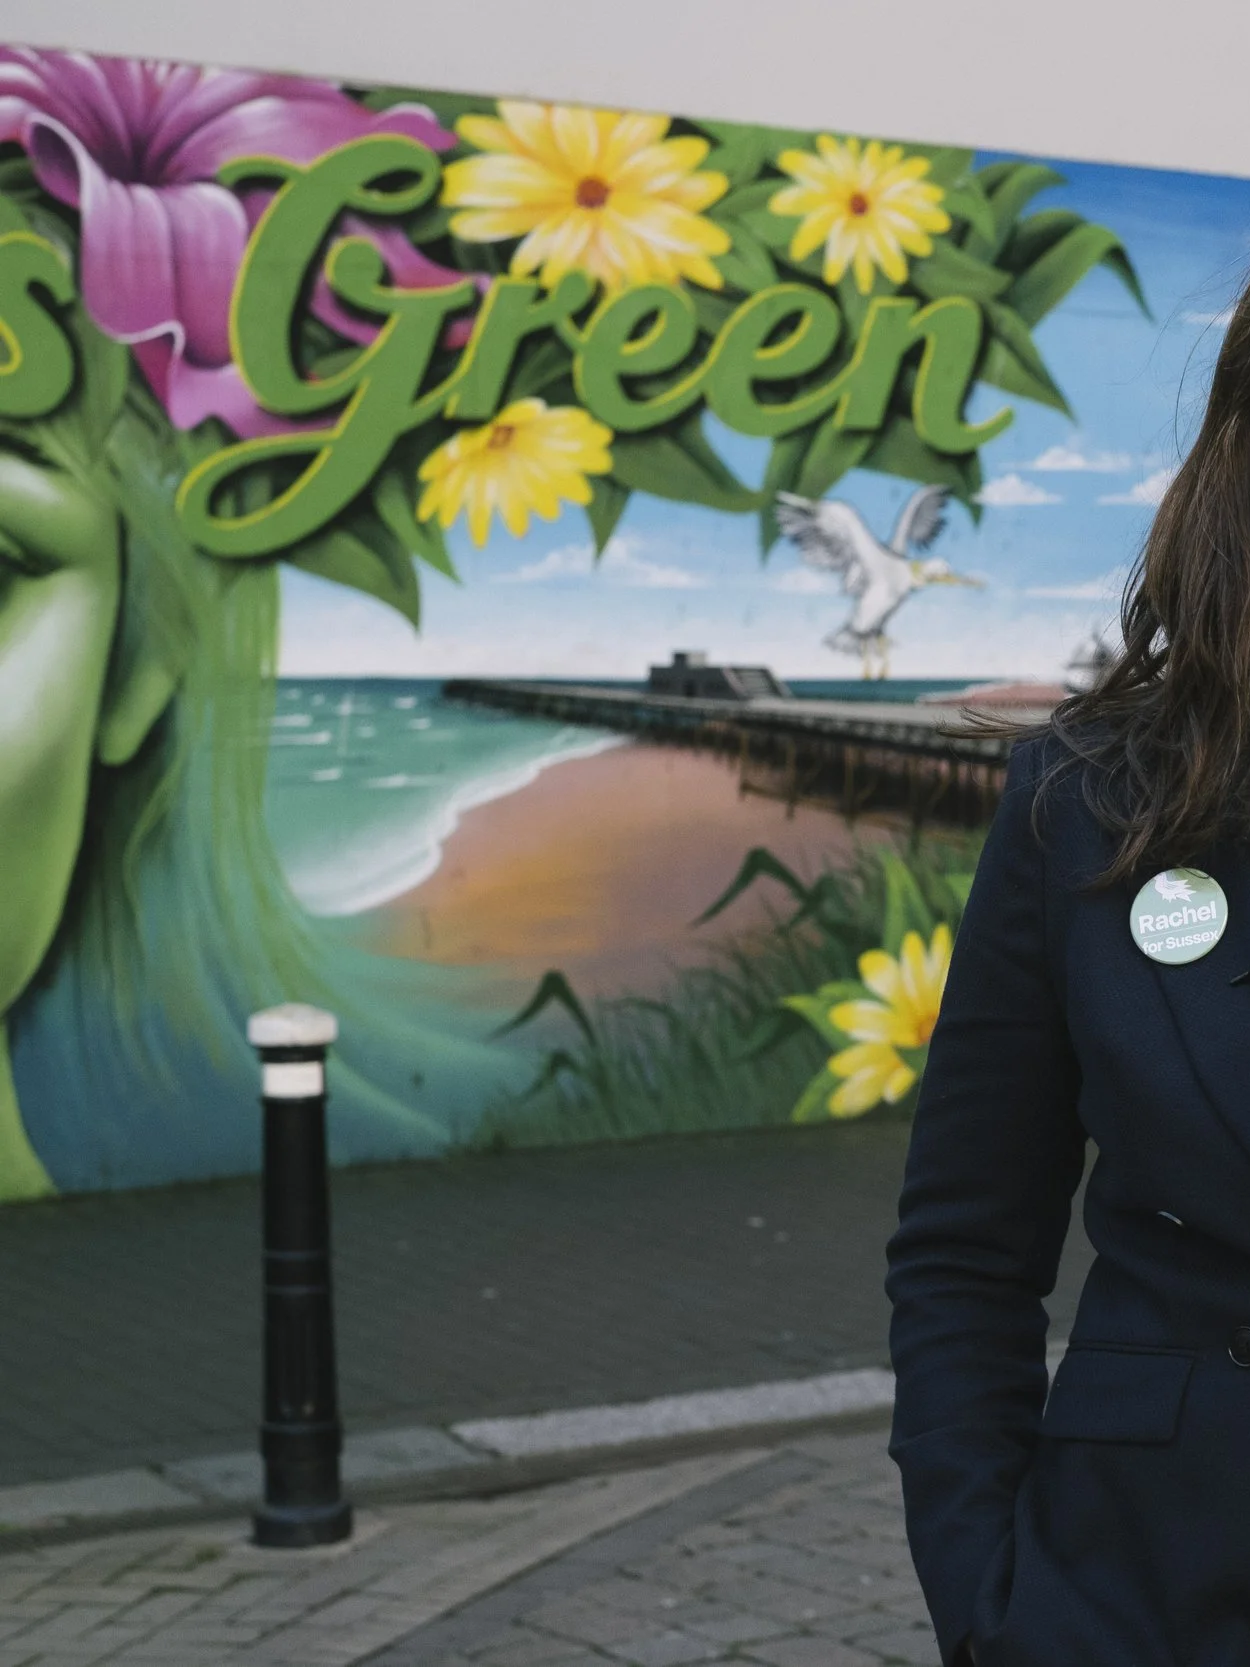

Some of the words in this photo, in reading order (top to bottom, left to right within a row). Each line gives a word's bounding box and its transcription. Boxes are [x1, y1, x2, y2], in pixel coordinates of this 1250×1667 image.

[176, 133, 1016, 555] Green
[1139, 901, 1217, 934] Rachel
[1142, 941, 1164, 955] for
[1166, 930, 1219, 949] Sussex
